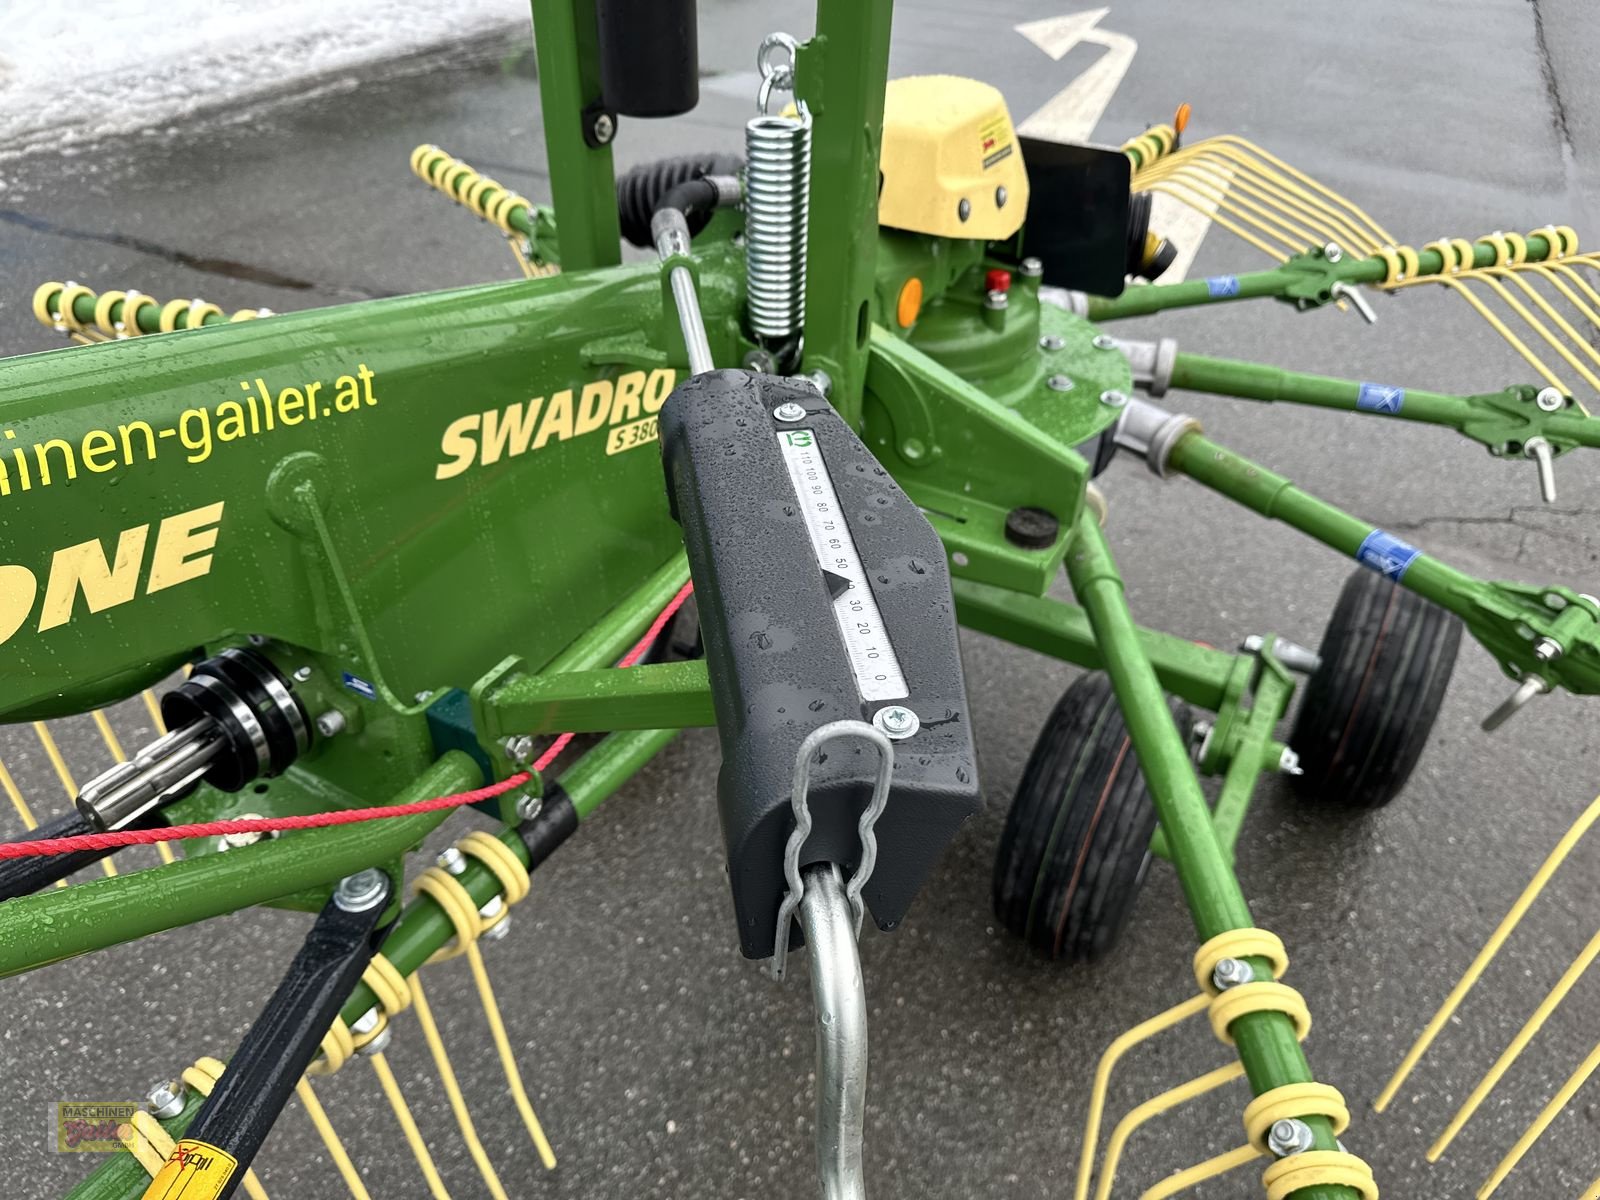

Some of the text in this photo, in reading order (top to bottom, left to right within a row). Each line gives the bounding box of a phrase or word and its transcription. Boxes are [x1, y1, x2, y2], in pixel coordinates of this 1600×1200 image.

[435, 368, 676, 480] SWADRO
[614, 419, 658, 450] S 380
[800, 451, 813, 465] 110
[806, 467, 818, 481] 100
[811, 485, 823, 495] 90
[816, 502, 829, 513] 80
[823, 520, 836, 531] 70
[828, 538, 842, 549] 60
[835, 558, 848, 569] 50
[849, 599, 863, 612] 30
[856, 622, 871, 635] 20
[865, 646, 879, 660] 10
[874, 674, 887, 682] 0
